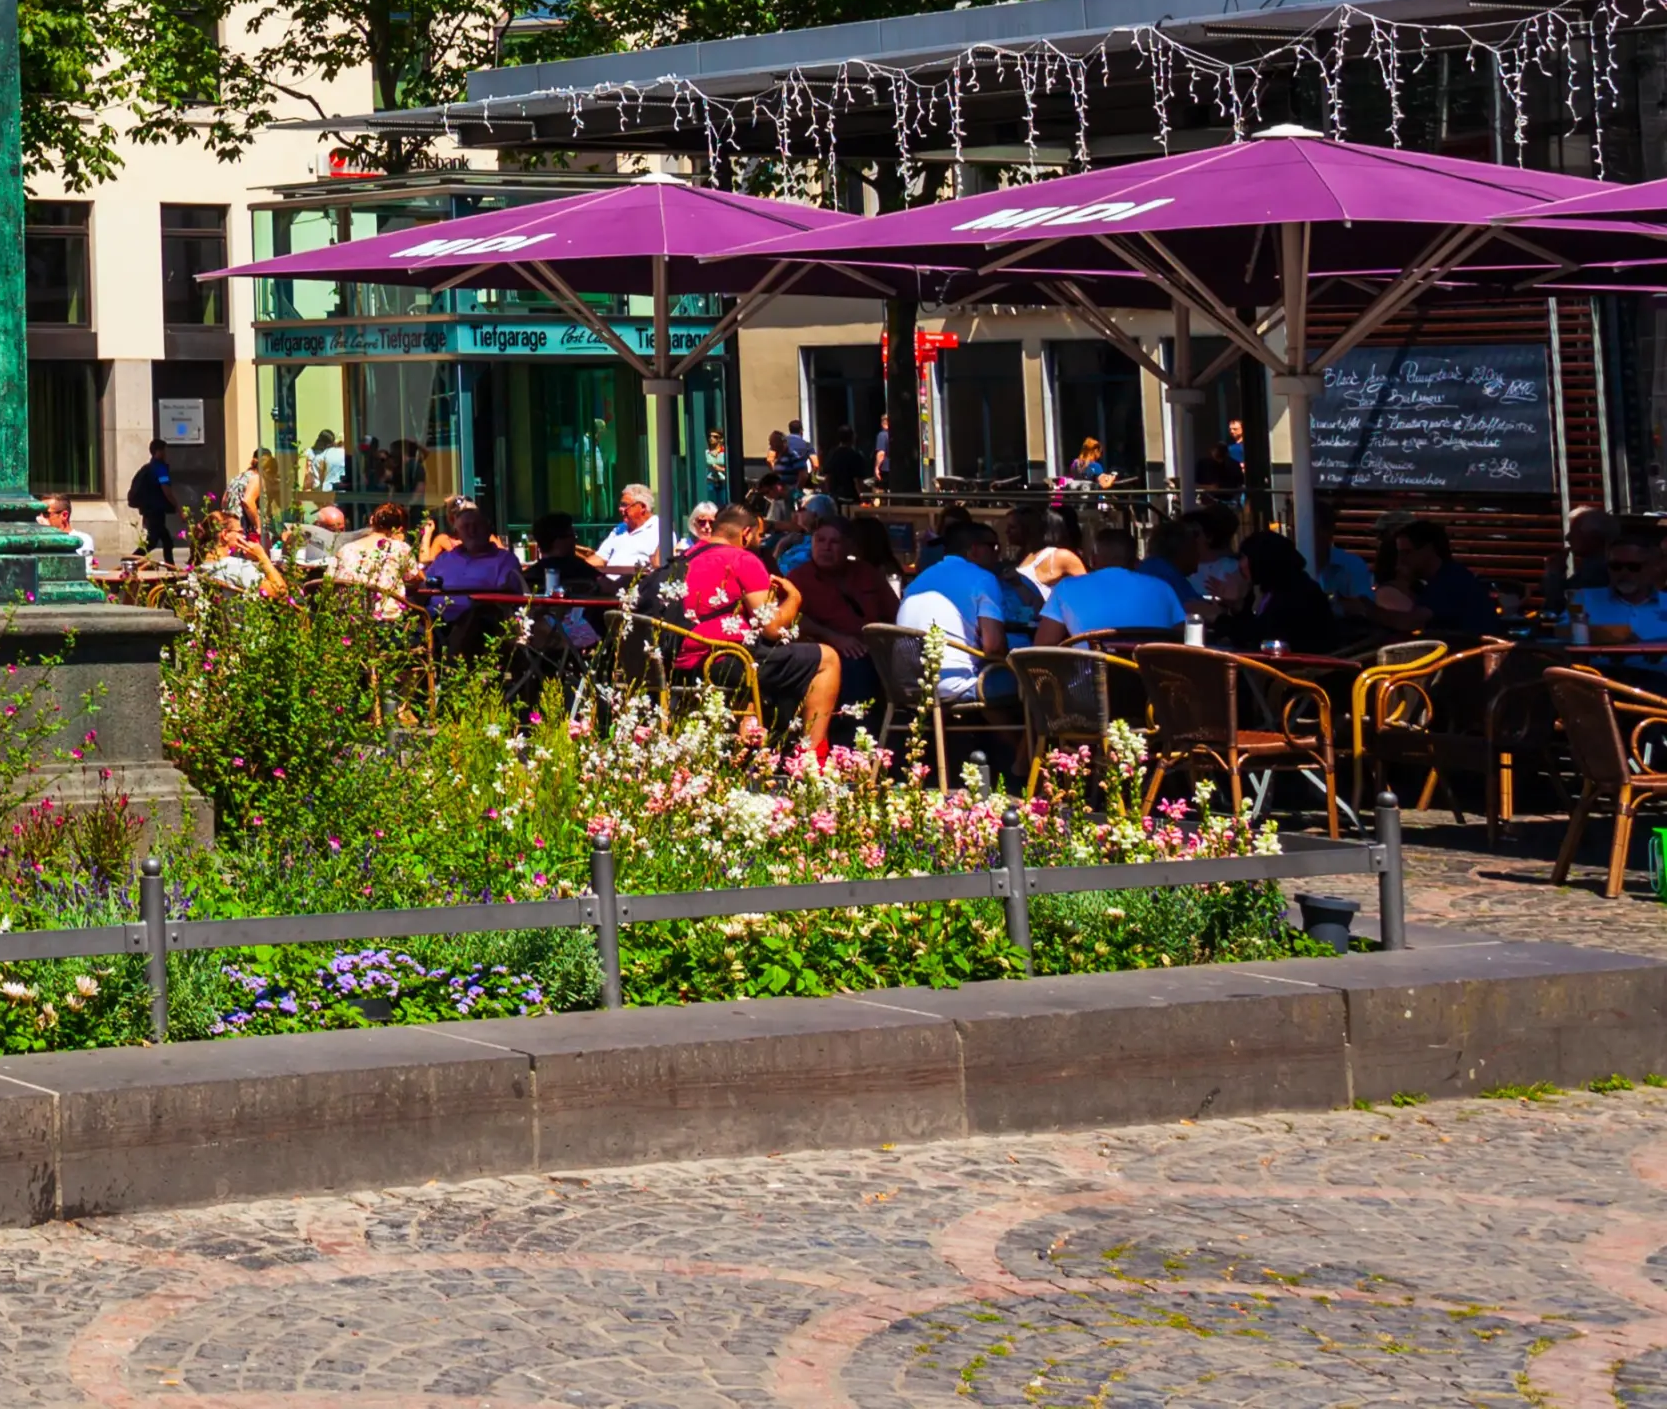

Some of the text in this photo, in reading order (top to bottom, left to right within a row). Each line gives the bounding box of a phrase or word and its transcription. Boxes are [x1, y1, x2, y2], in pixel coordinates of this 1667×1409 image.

[951, 198, 1175, 230] MIDI
[389, 233, 556, 258] MIDI
[264, 331, 325, 355] Tiefgarage
[378, 326, 447, 353] Tiefgarage
[470, 324, 547, 353] Tiefgarage
[561, 324, 585, 345] Post
